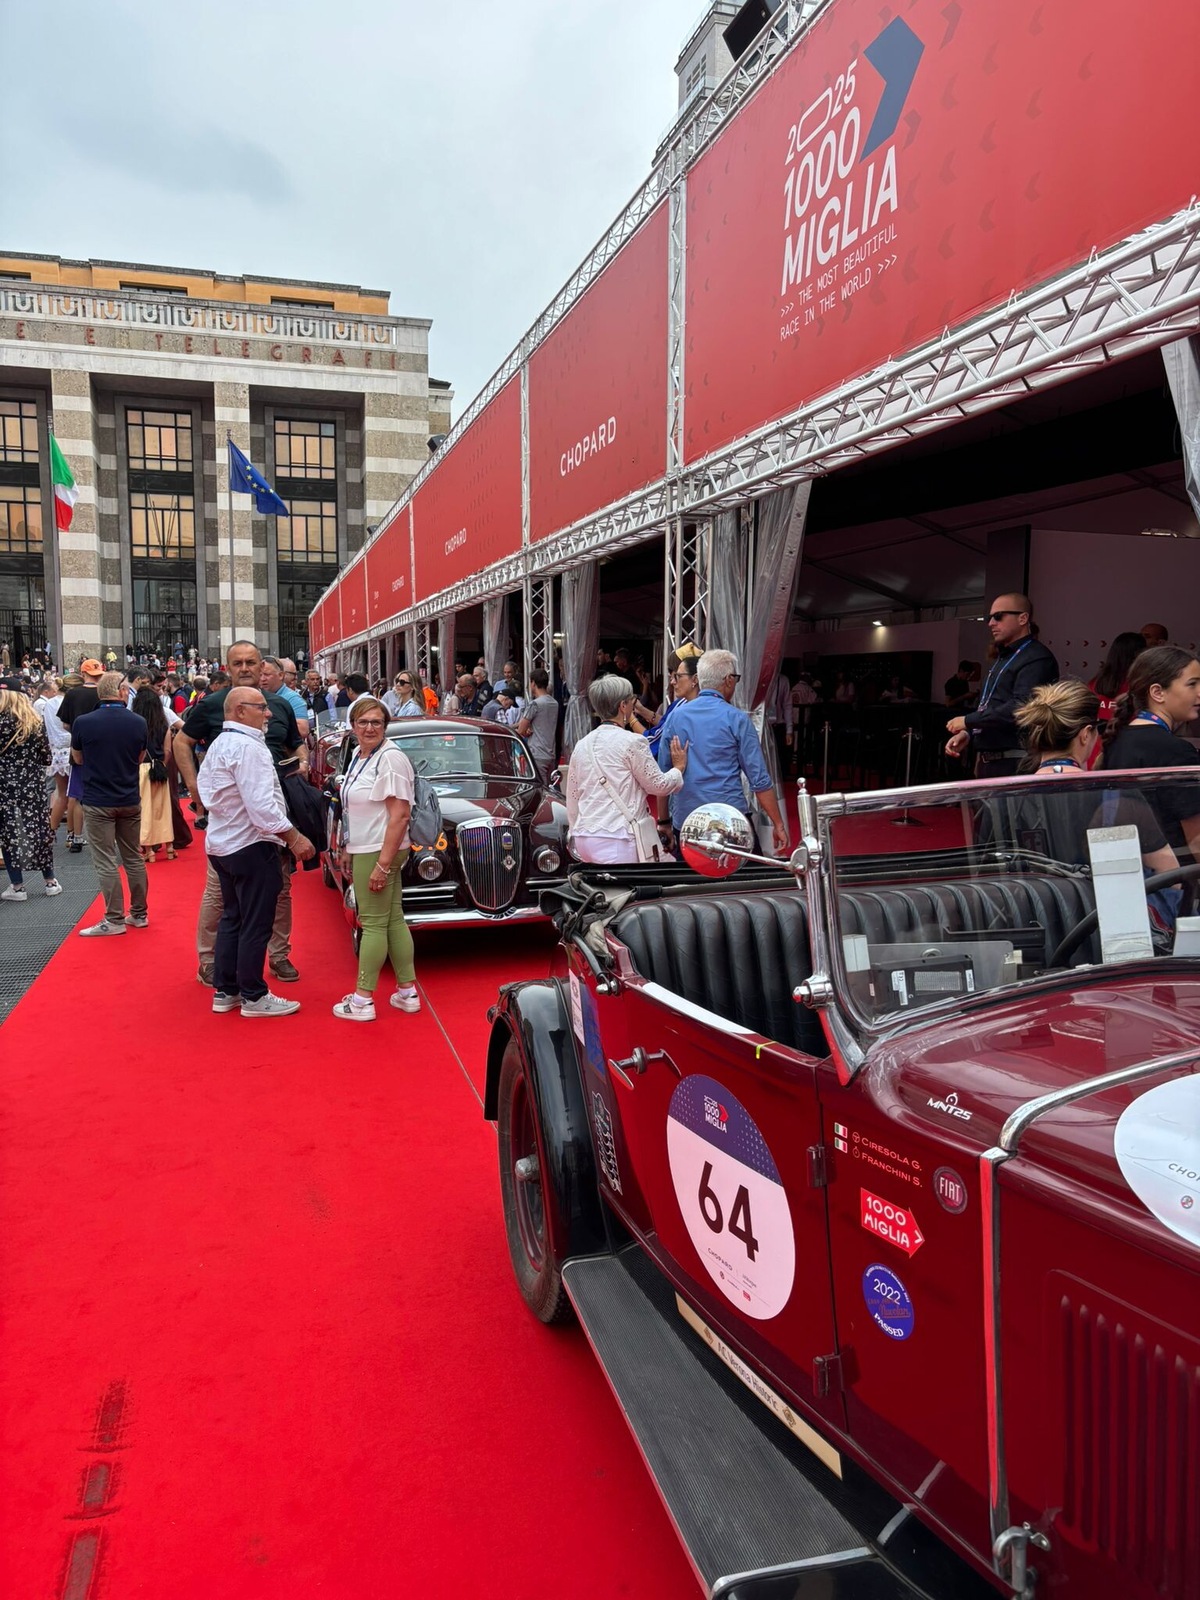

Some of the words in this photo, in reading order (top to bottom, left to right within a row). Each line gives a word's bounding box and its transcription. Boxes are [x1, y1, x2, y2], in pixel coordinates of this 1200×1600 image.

[784, 106, 860, 230] 1000
[781, 145, 898, 296] MIGLIA
[799, 283, 813, 305] THE
[817, 264, 839, 293] MOST
[843, 223, 898, 274] BEAUTIFUL
[780, 316, 799, 341] RACE
[804, 306, 815, 326] IN
[819, 291, 836, 314] THE
[841, 267, 872, 300] WORLD
[85, 327, 96, 345] E
[155, 333, 397, 370] TELEGRAFI
[560, 416, 617, 477] CHOPARD
[444, 527, 467, 556] CHOPARD
[704, 1102, 720, 1118] 1000
[705, 1112, 728, 1134] MIGLIA
[927, 1097, 973, 1121] MNT25
[861, 1137, 910, 1166] CIRESOLA
[911, 1160, 922, 1171] G.
[861, 1152, 911, 1182] FRANCHINI
[912, 1176, 923, 1188] S.
[939, 1177, 961, 1202] FIAT
[698, 1161, 759, 1263] 64
[866, 1196, 907, 1226] 1000
[864, 1213, 910, 1248] MIGLIA
[873, 1278, 901, 1306] 2022
[874, 1313, 904, 1337] PASSED
